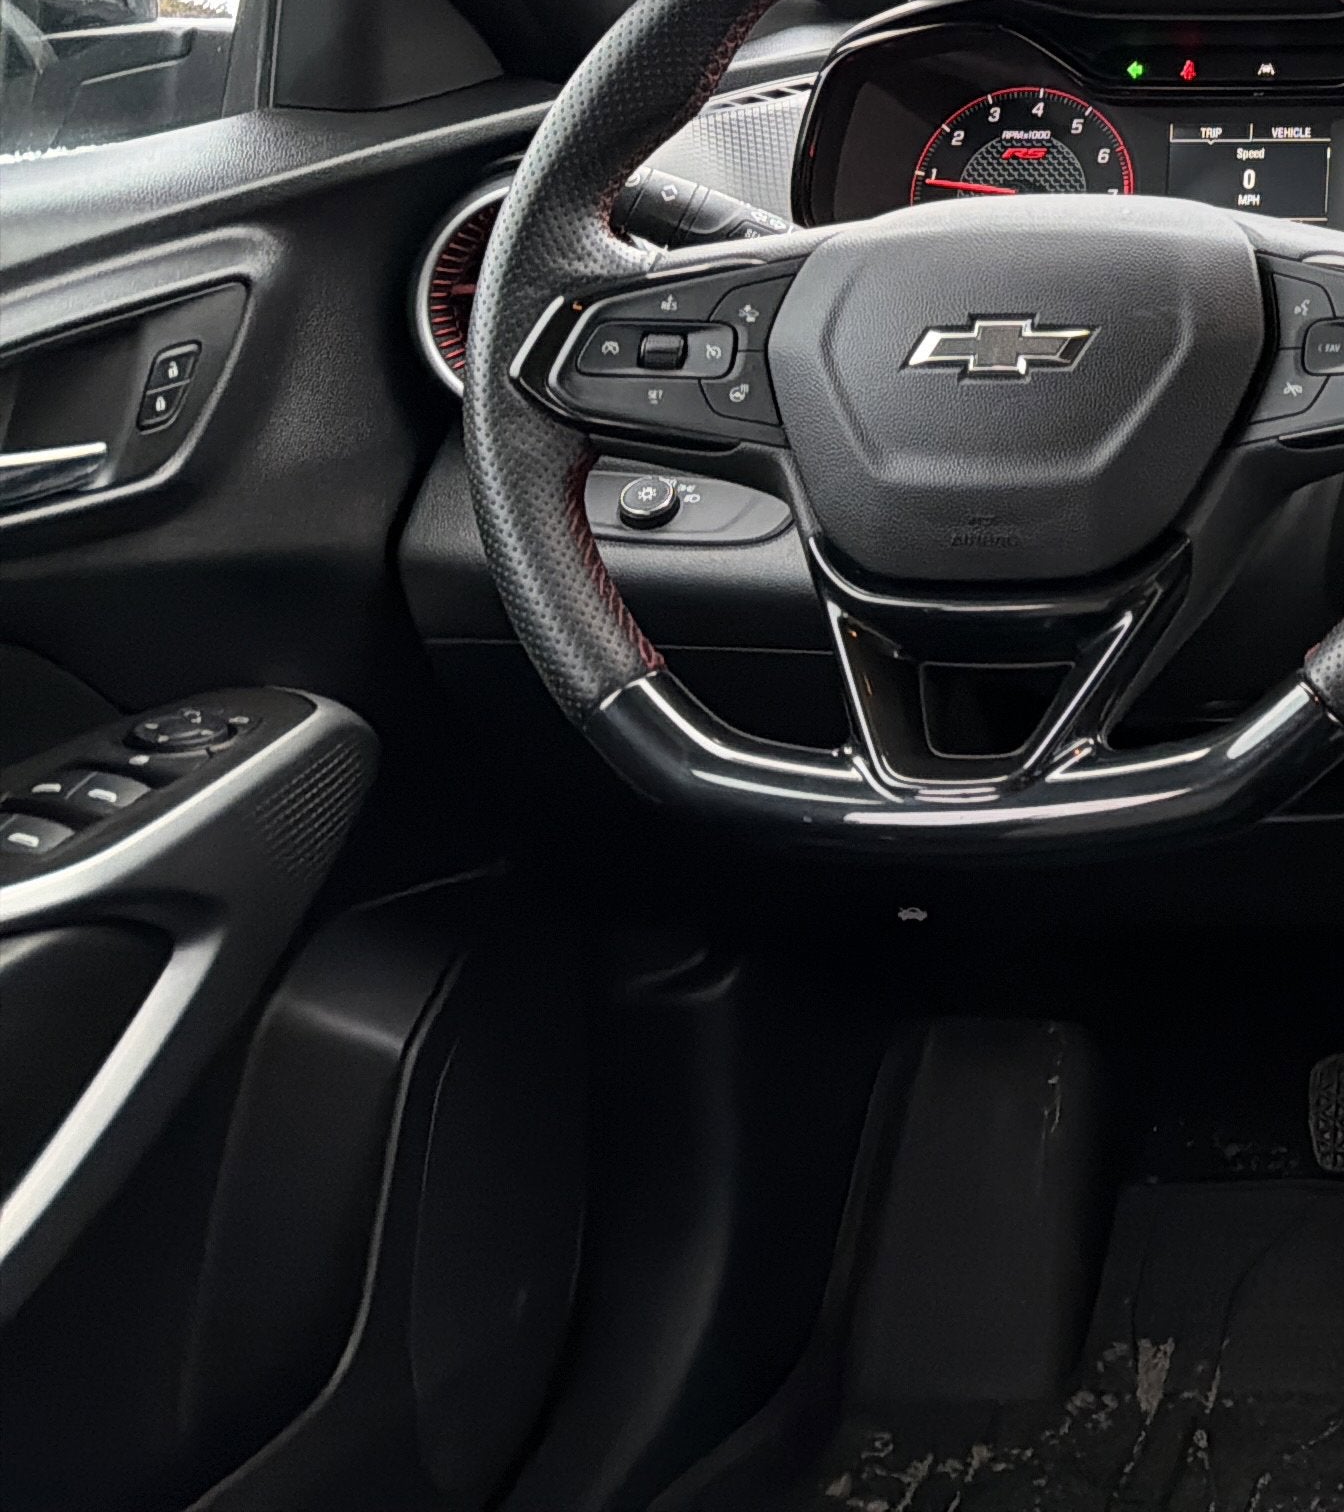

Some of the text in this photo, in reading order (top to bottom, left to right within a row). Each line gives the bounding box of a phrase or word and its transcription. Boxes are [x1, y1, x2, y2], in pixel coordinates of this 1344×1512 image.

[988, 107, 1001, 123] 3
[1032, 102, 1044, 118] 4
[1071, 118, 1084, 134] 5
[1200, 127, 1223, 138] TRIP
[1271, 126, 1312, 138] VEHICLE
[951, 130, 965, 146] 2
[1002, 147, 1048, 160] RS
[1098, 148, 1111, 164] 6
[1236, 147, 1266, 161] Speed
[931, 168, 938, 180] 1
[1242, 168, 1256, 190] 0
[1238, 194, 1261, 206] MPH
